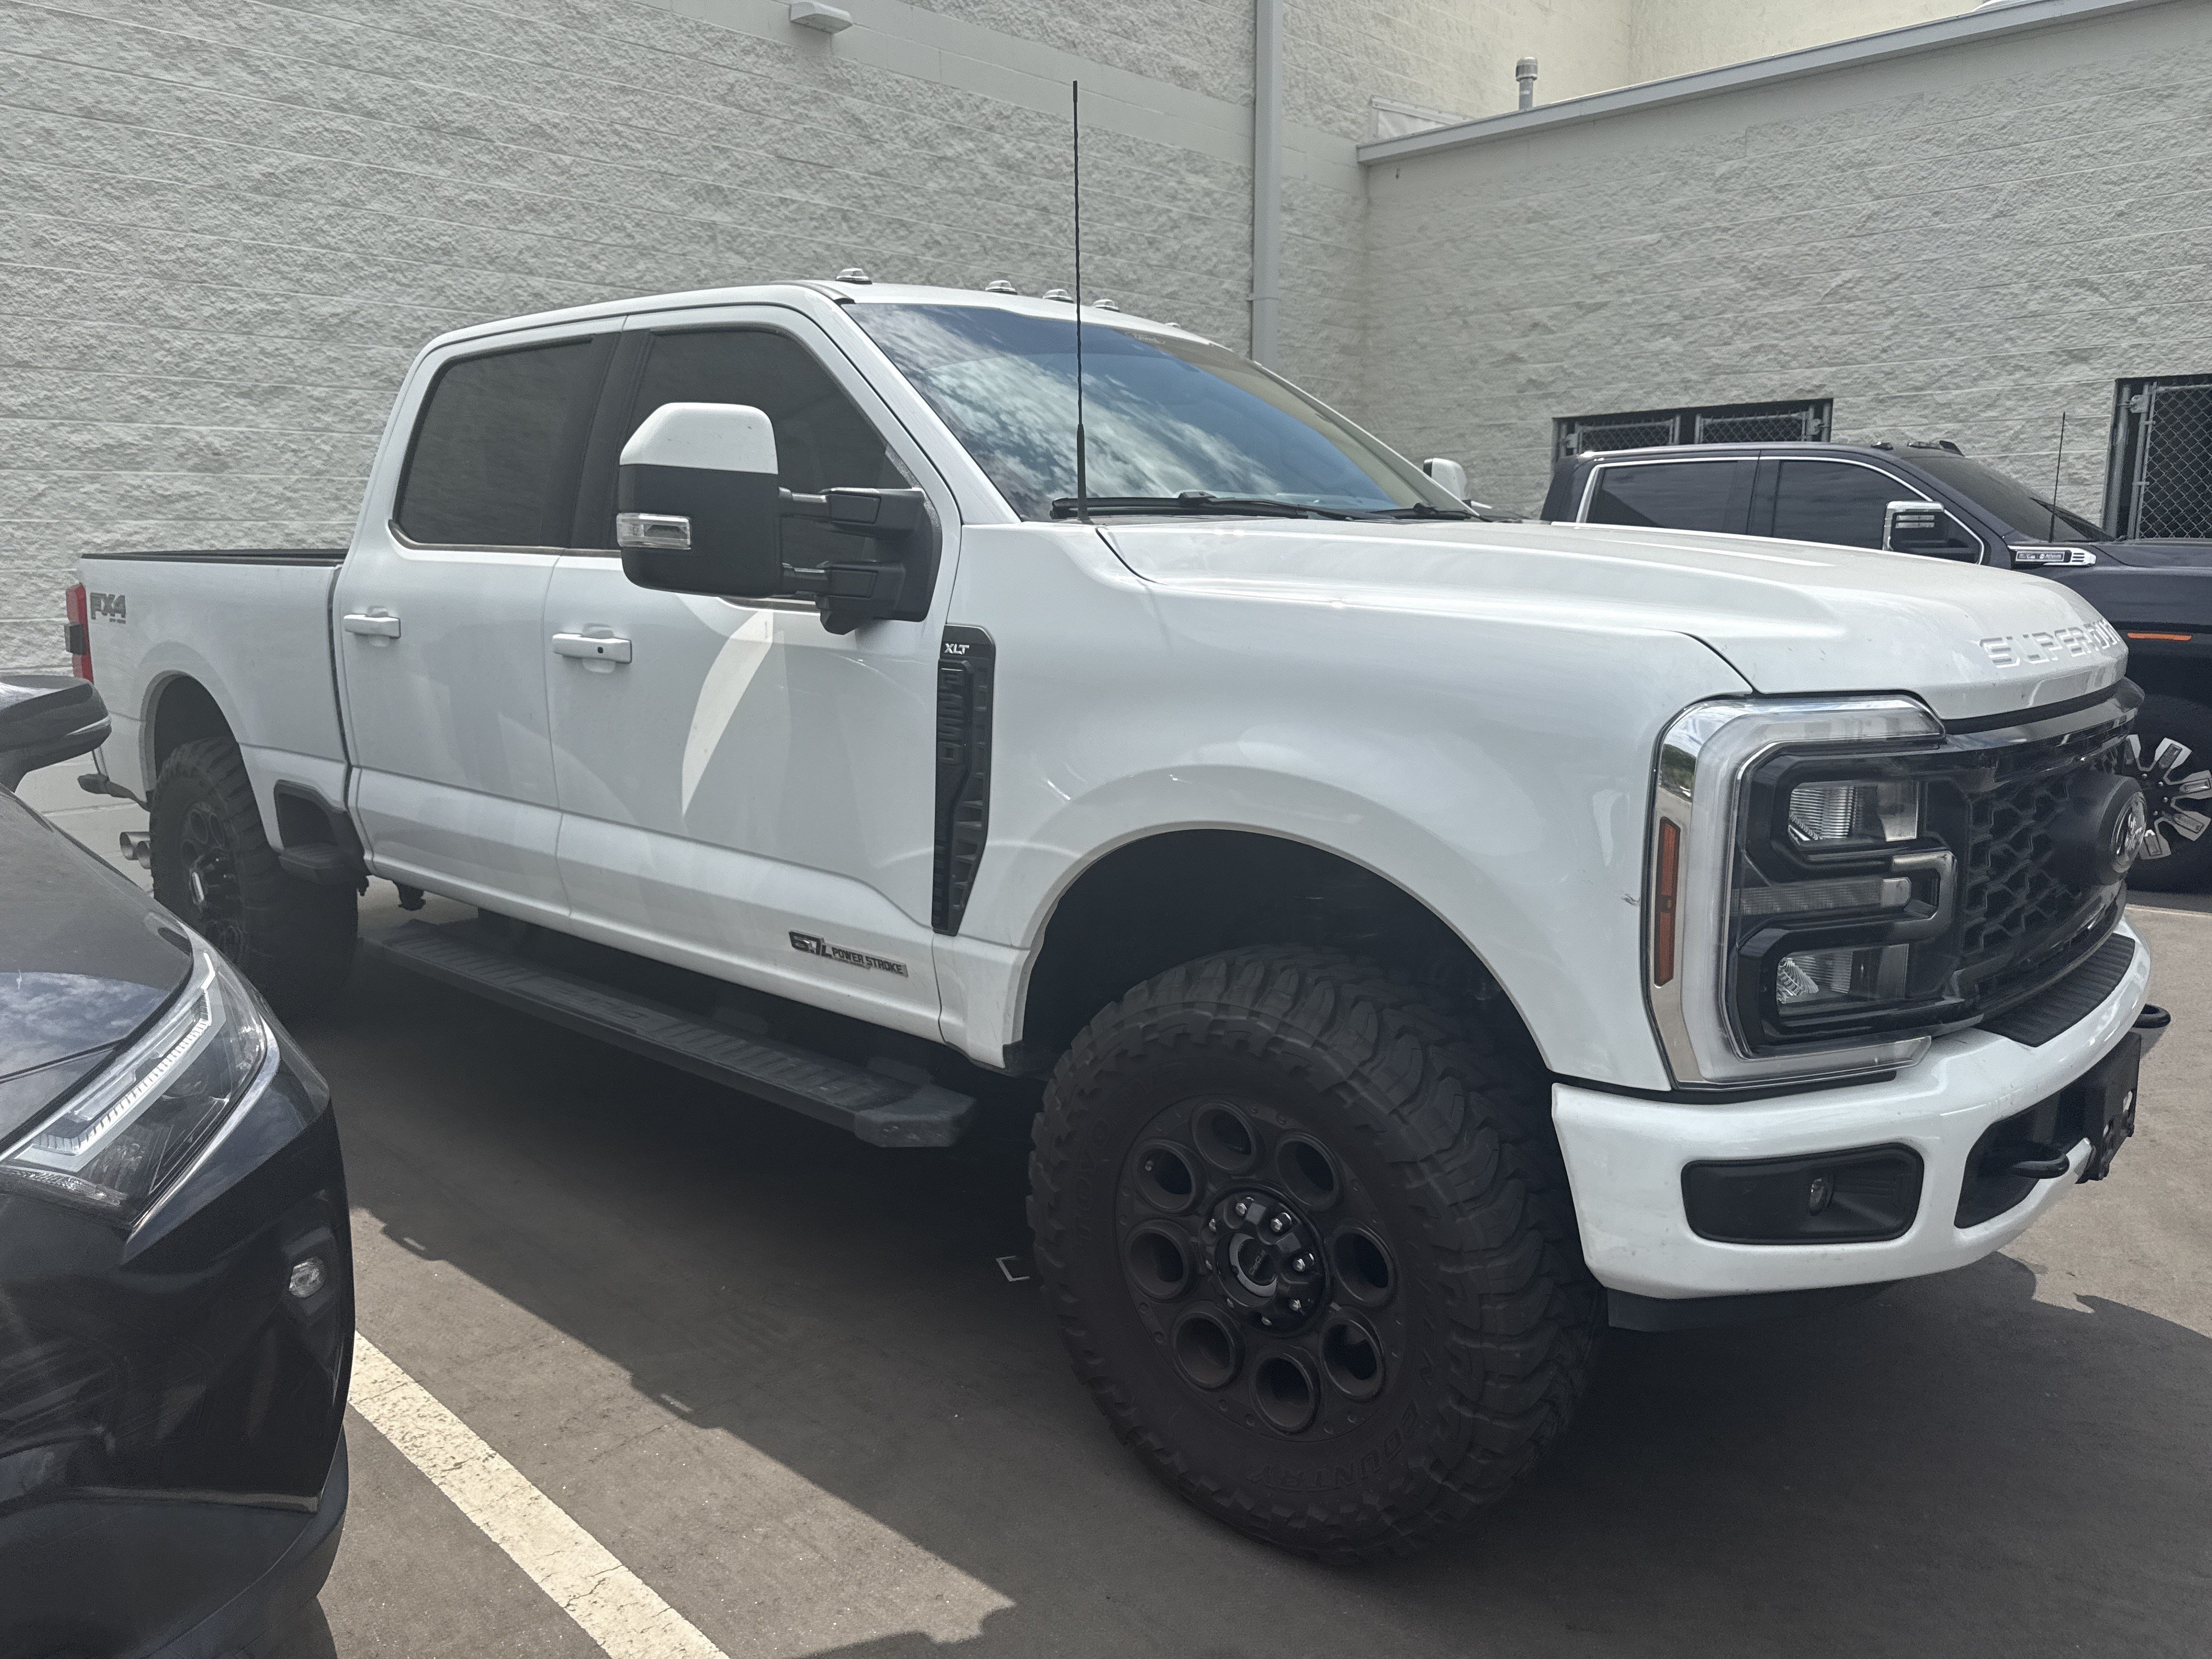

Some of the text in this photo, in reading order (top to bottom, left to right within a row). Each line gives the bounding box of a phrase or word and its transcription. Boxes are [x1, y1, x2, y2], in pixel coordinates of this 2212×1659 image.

[90, 592, 126, 620] FX4
[944, 643, 970, 654] XLT
[831, 947, 865, 964] POWER
[865, 956, 904, 975] STROKE
